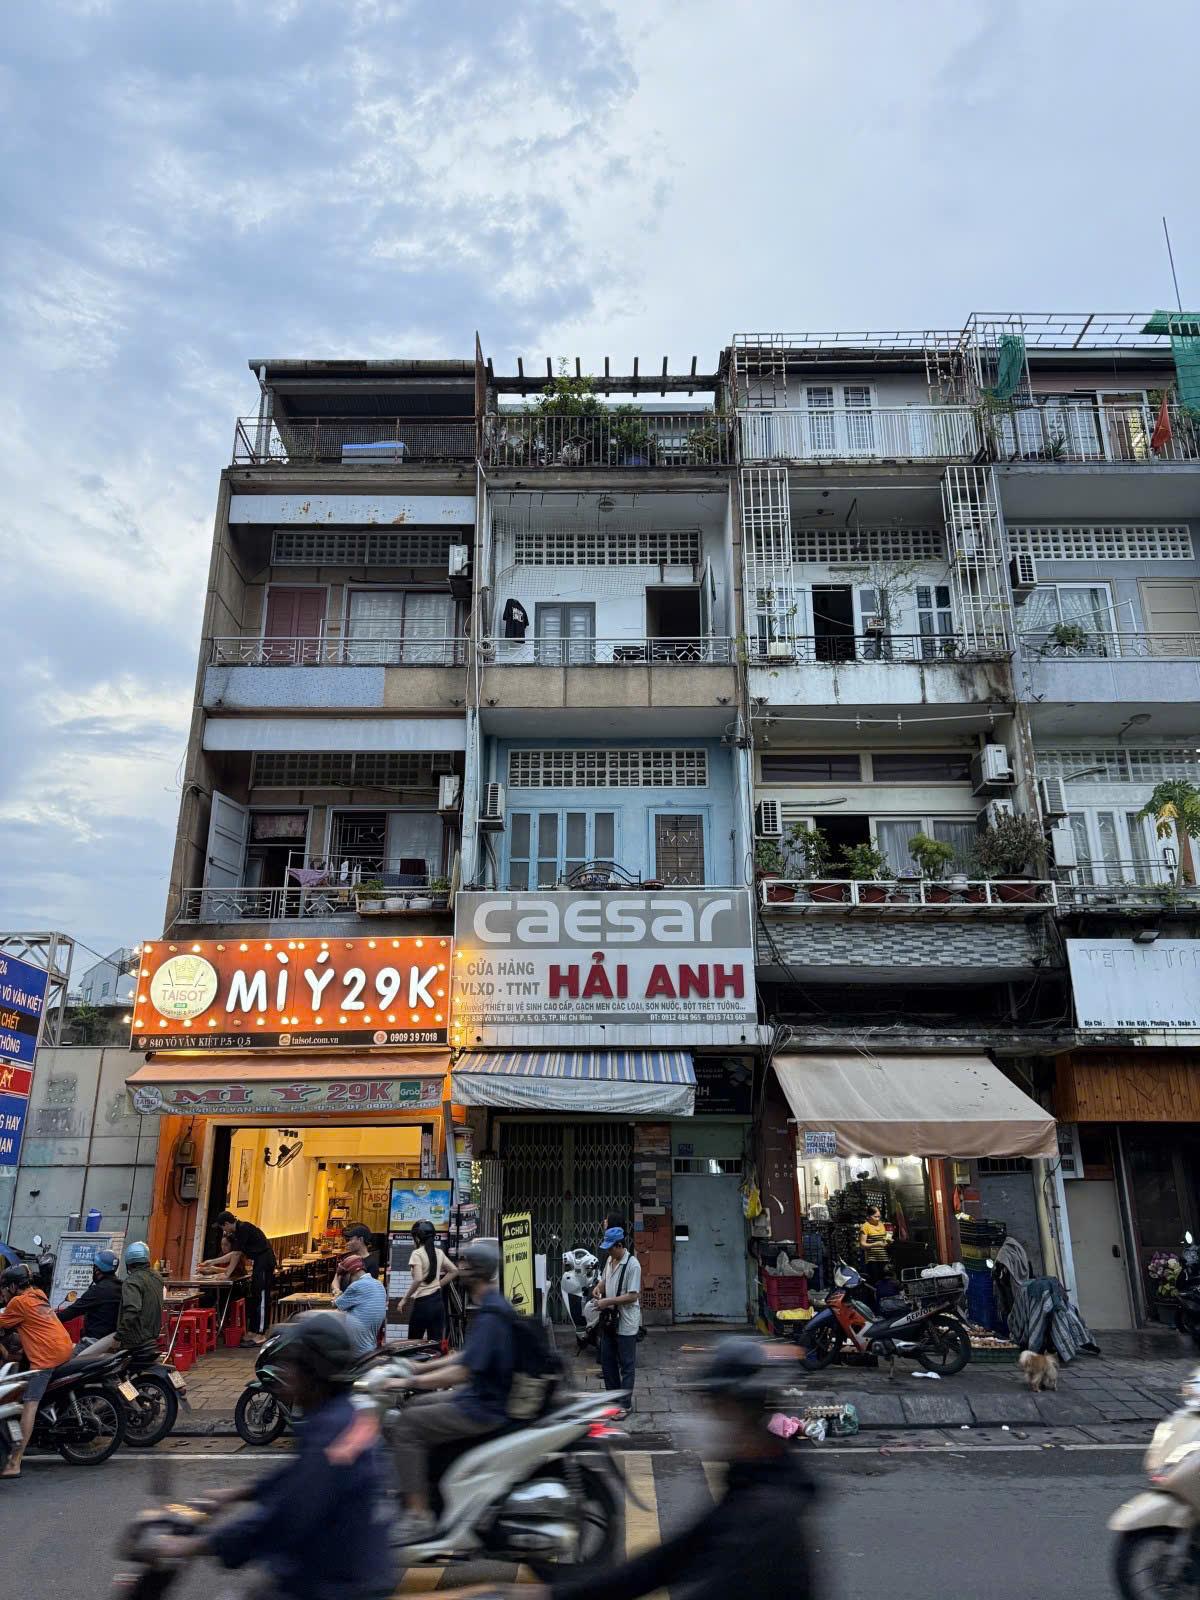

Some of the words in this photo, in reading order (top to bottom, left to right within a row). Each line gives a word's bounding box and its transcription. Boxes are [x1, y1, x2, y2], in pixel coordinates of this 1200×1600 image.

[467, 957, 494, 976] CỬA
[497, 957, 535, 976] HÀNG
[549, 951, 628, 998] HẢI
[645, 963, 745, 998] ANH
[226, 951, 289, 1013] MÌ
[461, 982, 494, 996] VLXD
[506, 981, 541, 996] TTNT
[162, 989, 207, 1002] TAISOT
[526, 1002, 541, 1011] SINH
[543, 1002, 558, 1011] CAO
[596, 1002, 610, 1011] MEN
[291, 1036, 339, 1044] taisot.com.vn
[390, 1032, 409, 1042] 0909
[171, 1084, 253, 1104] MÌ
[327, 1081, 393, 1103] 29K
[400, 1088, 420, 1097] Grab
[5, 1115, 21, 1131] HAY
[362, 1192, 389, 1203] TAISO
